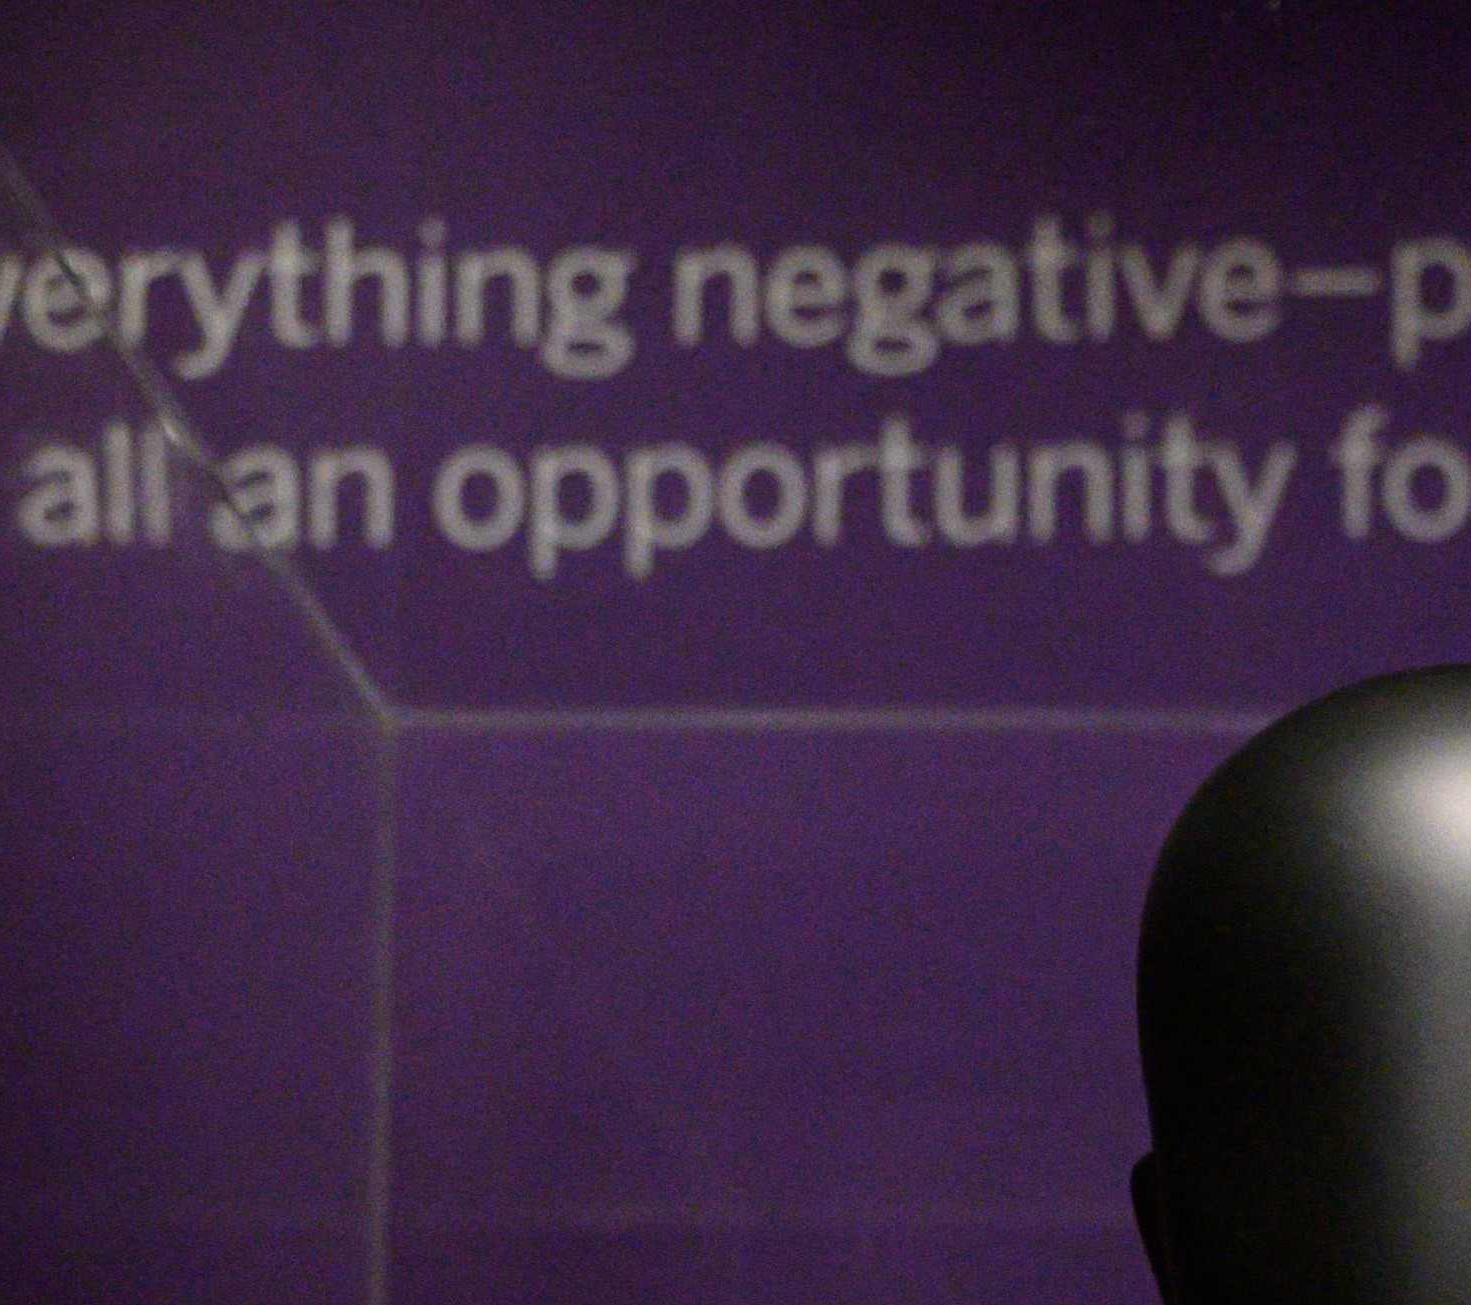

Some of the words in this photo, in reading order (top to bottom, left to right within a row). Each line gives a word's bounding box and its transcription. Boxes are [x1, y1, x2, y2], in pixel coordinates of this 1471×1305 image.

[16, 420, 172, 548] all
[210, 444, 396, 552] an
[430, 412, 1298, 582] opportunity
